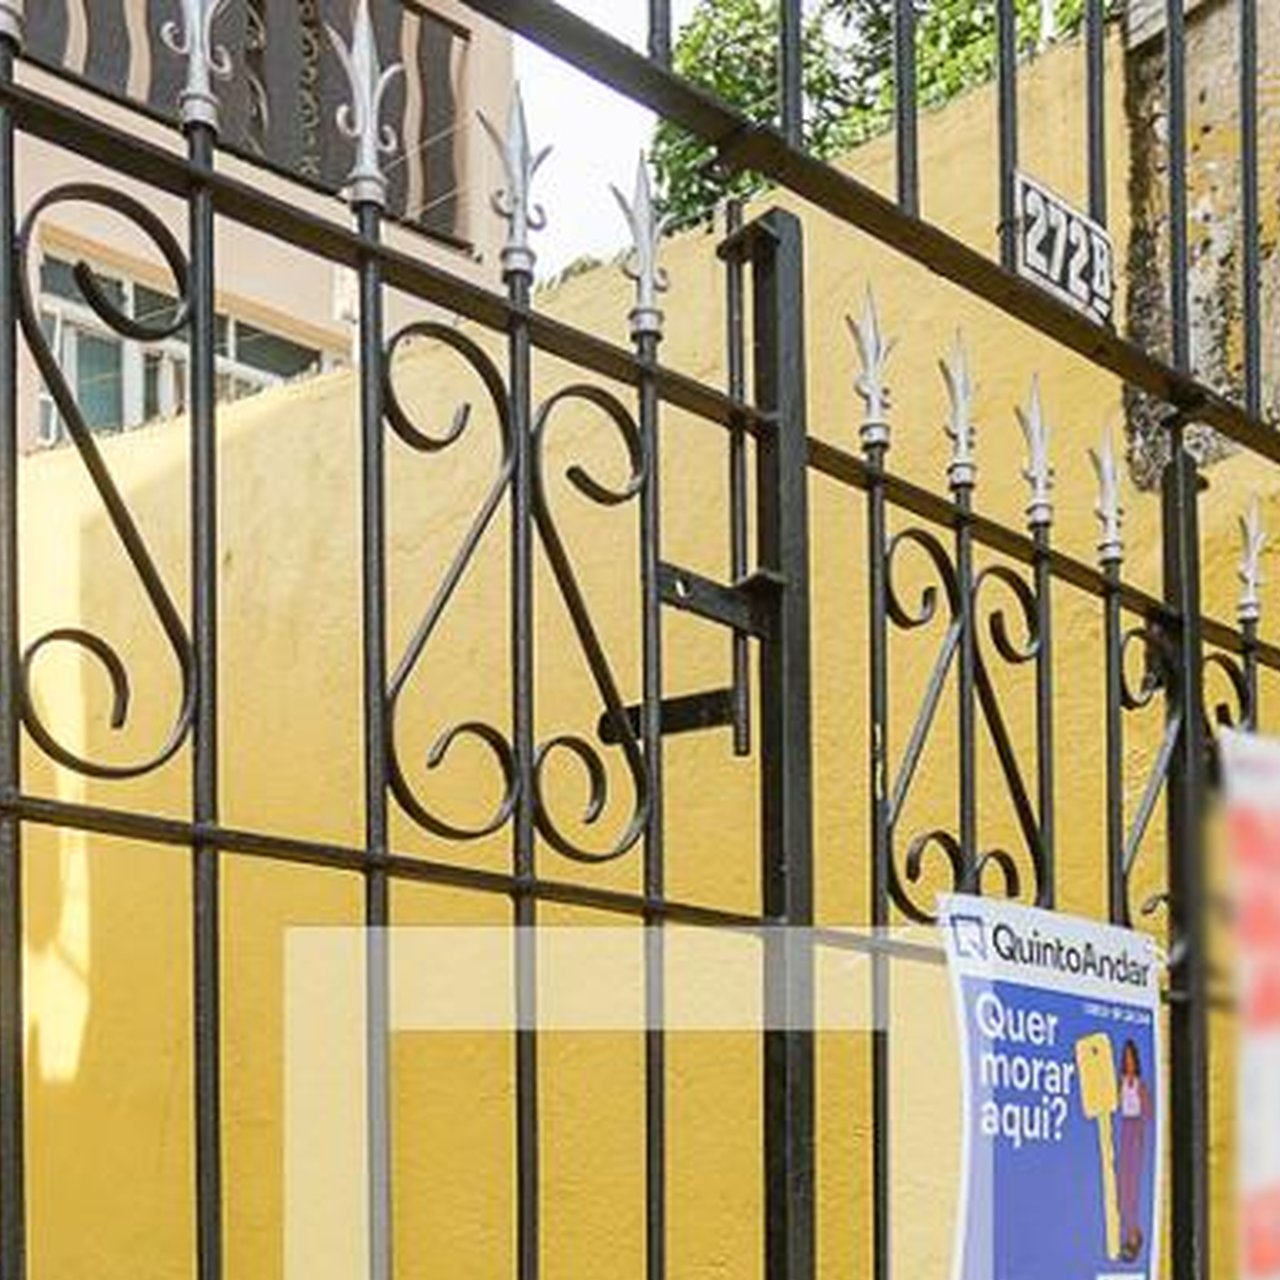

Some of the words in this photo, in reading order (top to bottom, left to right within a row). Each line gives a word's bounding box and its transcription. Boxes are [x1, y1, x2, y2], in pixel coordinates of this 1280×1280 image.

[992, 923, 1150, 987] QuintoAndar
[976, 991, 1058, 1046] Quer
[981, 1053, 1075, 1095] morar
[981, 1095, 1068, 1148] aqui?
